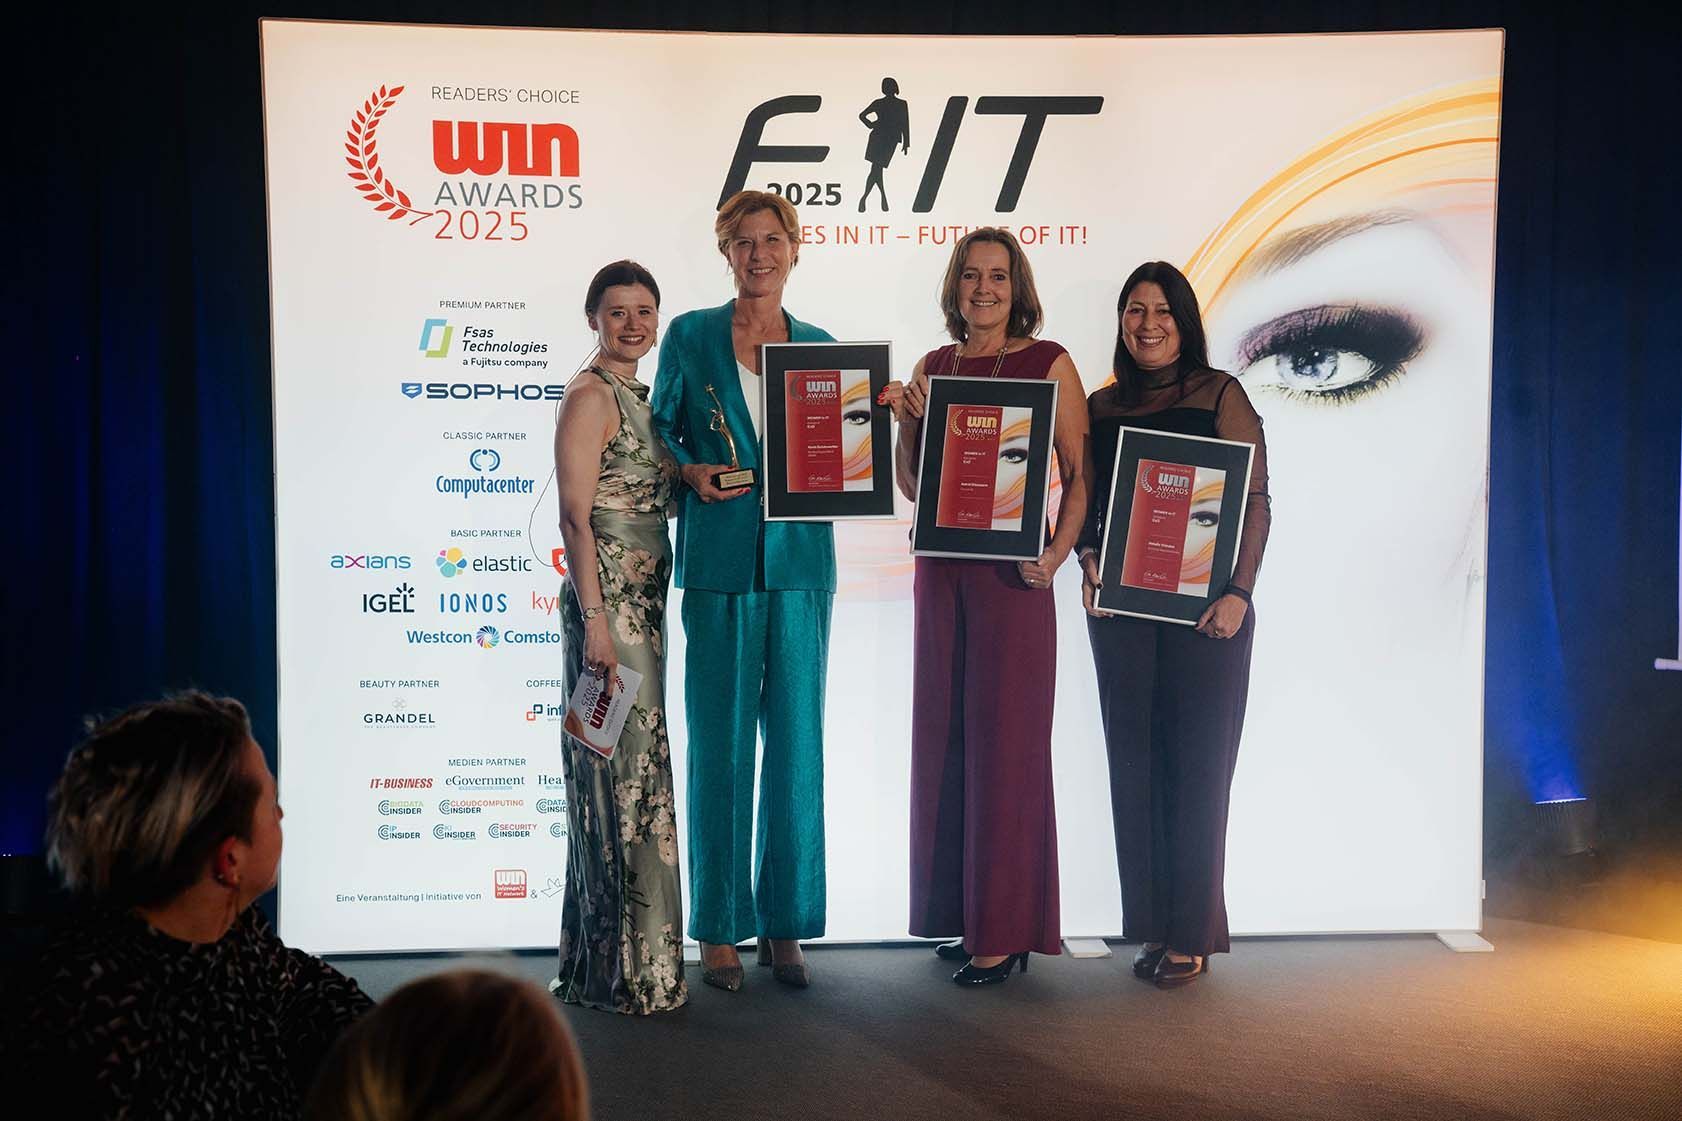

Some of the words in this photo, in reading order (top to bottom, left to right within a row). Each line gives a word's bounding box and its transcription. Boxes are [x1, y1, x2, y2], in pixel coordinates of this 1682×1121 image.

[517, 89, 579, 103] CHOICE
[912, 96, 1104, 213] IT
[435, 182, 582, 210] AWARDS
[435, 210, 528, 240] 2025
[837, 226, 858, 244] IN
[870, 226, 889, 244] IT
[1020, 226, 1050, 244] OF
[1060, 226, 1086, 244] IT!
[440, 300, 482, 308] PREMIUM
[484, 302, 526, 310] PARTNER
[464, 326, 494, 338] Fsas
[463, 340, 547, 355] Technologies
[470, 358, 502, 368] Fujitsu
[504, 360, 548, 370] company
[426, 383, 566, 400] SOPHOS
[442, 432, 482, 440] CLASSIC
[486, 432, 526, 440] PARTNER
[436, 476, 534, 498] Computacenter
[1156, 485, 1189, 496] AWARDS
[450, 530, 478, 538] BASIC
[480, 530, 522, 538] PARTNER
[330, 556, 412, 568] axians
[473, 556, 531, 571] elastic
[362, 590, 415, 613] IGEL
[441, 594, 507, 613] IONOS
[406, 630, 472, 644] Westcon
[360, 680, 396, 688] BEAUTY
[526, 680, 560, 688] COFFEE
[364, 714, 436, 724] GRANDEL
[448, 758, 482, 766] MEDIEN
[370, 778, 434, 788] IT-BUSINESS
[446, 776, 524, 786] eGovernment
[450, 800, 524, 808] CLOUDCOMPUTING
[336, 894, 356, 902] Eine
[426, 892, 464, 901] Initiative
[530, 890, 538, 900] &
